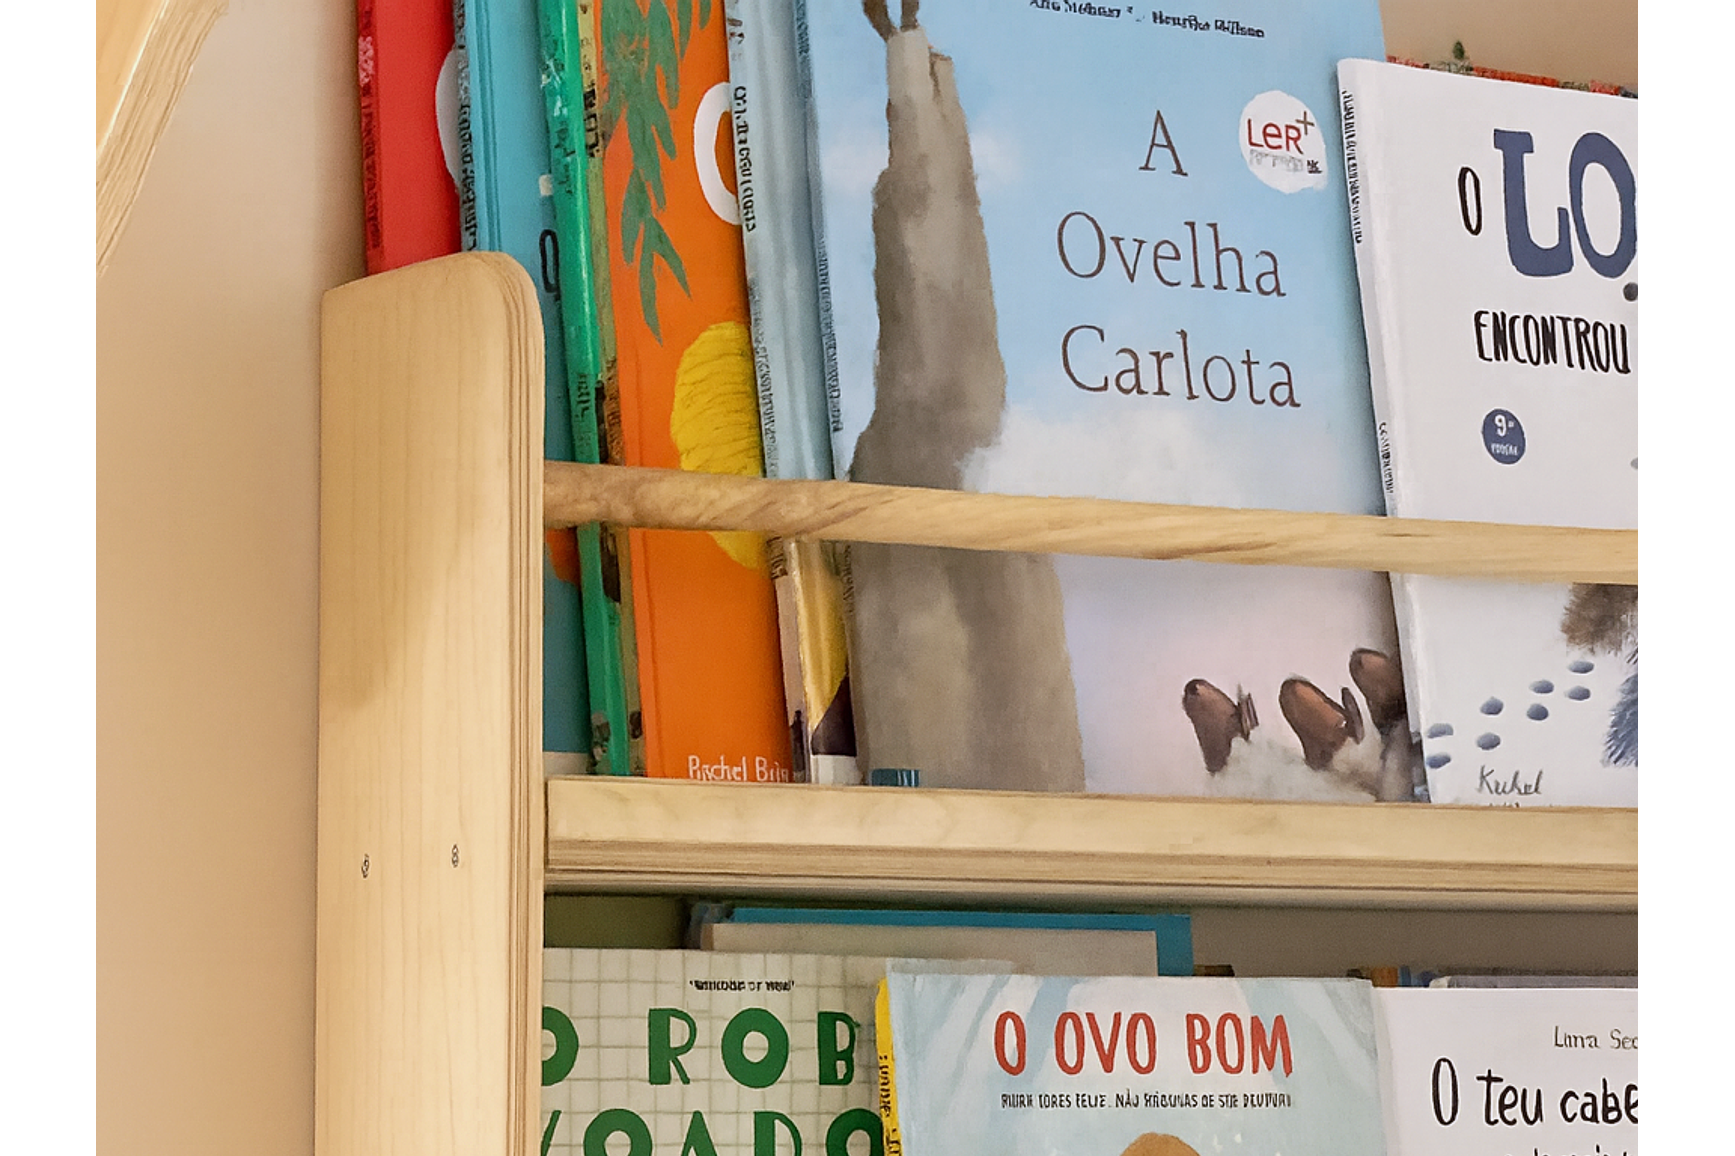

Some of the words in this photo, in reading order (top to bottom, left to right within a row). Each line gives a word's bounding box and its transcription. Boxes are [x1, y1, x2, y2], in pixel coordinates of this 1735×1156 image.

[1139, 109, 1188, 176] A
[1458, 166, 1483, 236] O
[1057, 211, 1286, 298] Ovelha
[1061, 325, 1301, 408] Carlota
[1474, 310, 1631, 374] ENCONTROU
[994, 1011, 1026, 1076] O
[1053, 1011, 1157, 1075] OVO
[1186, 1013, 1293, 1078] BOM
[1431, 1057, 1458, 1126] O
[1476, 1069, 1544, 1126] teu
[1560, 1077, 1638, 1125] cabe
